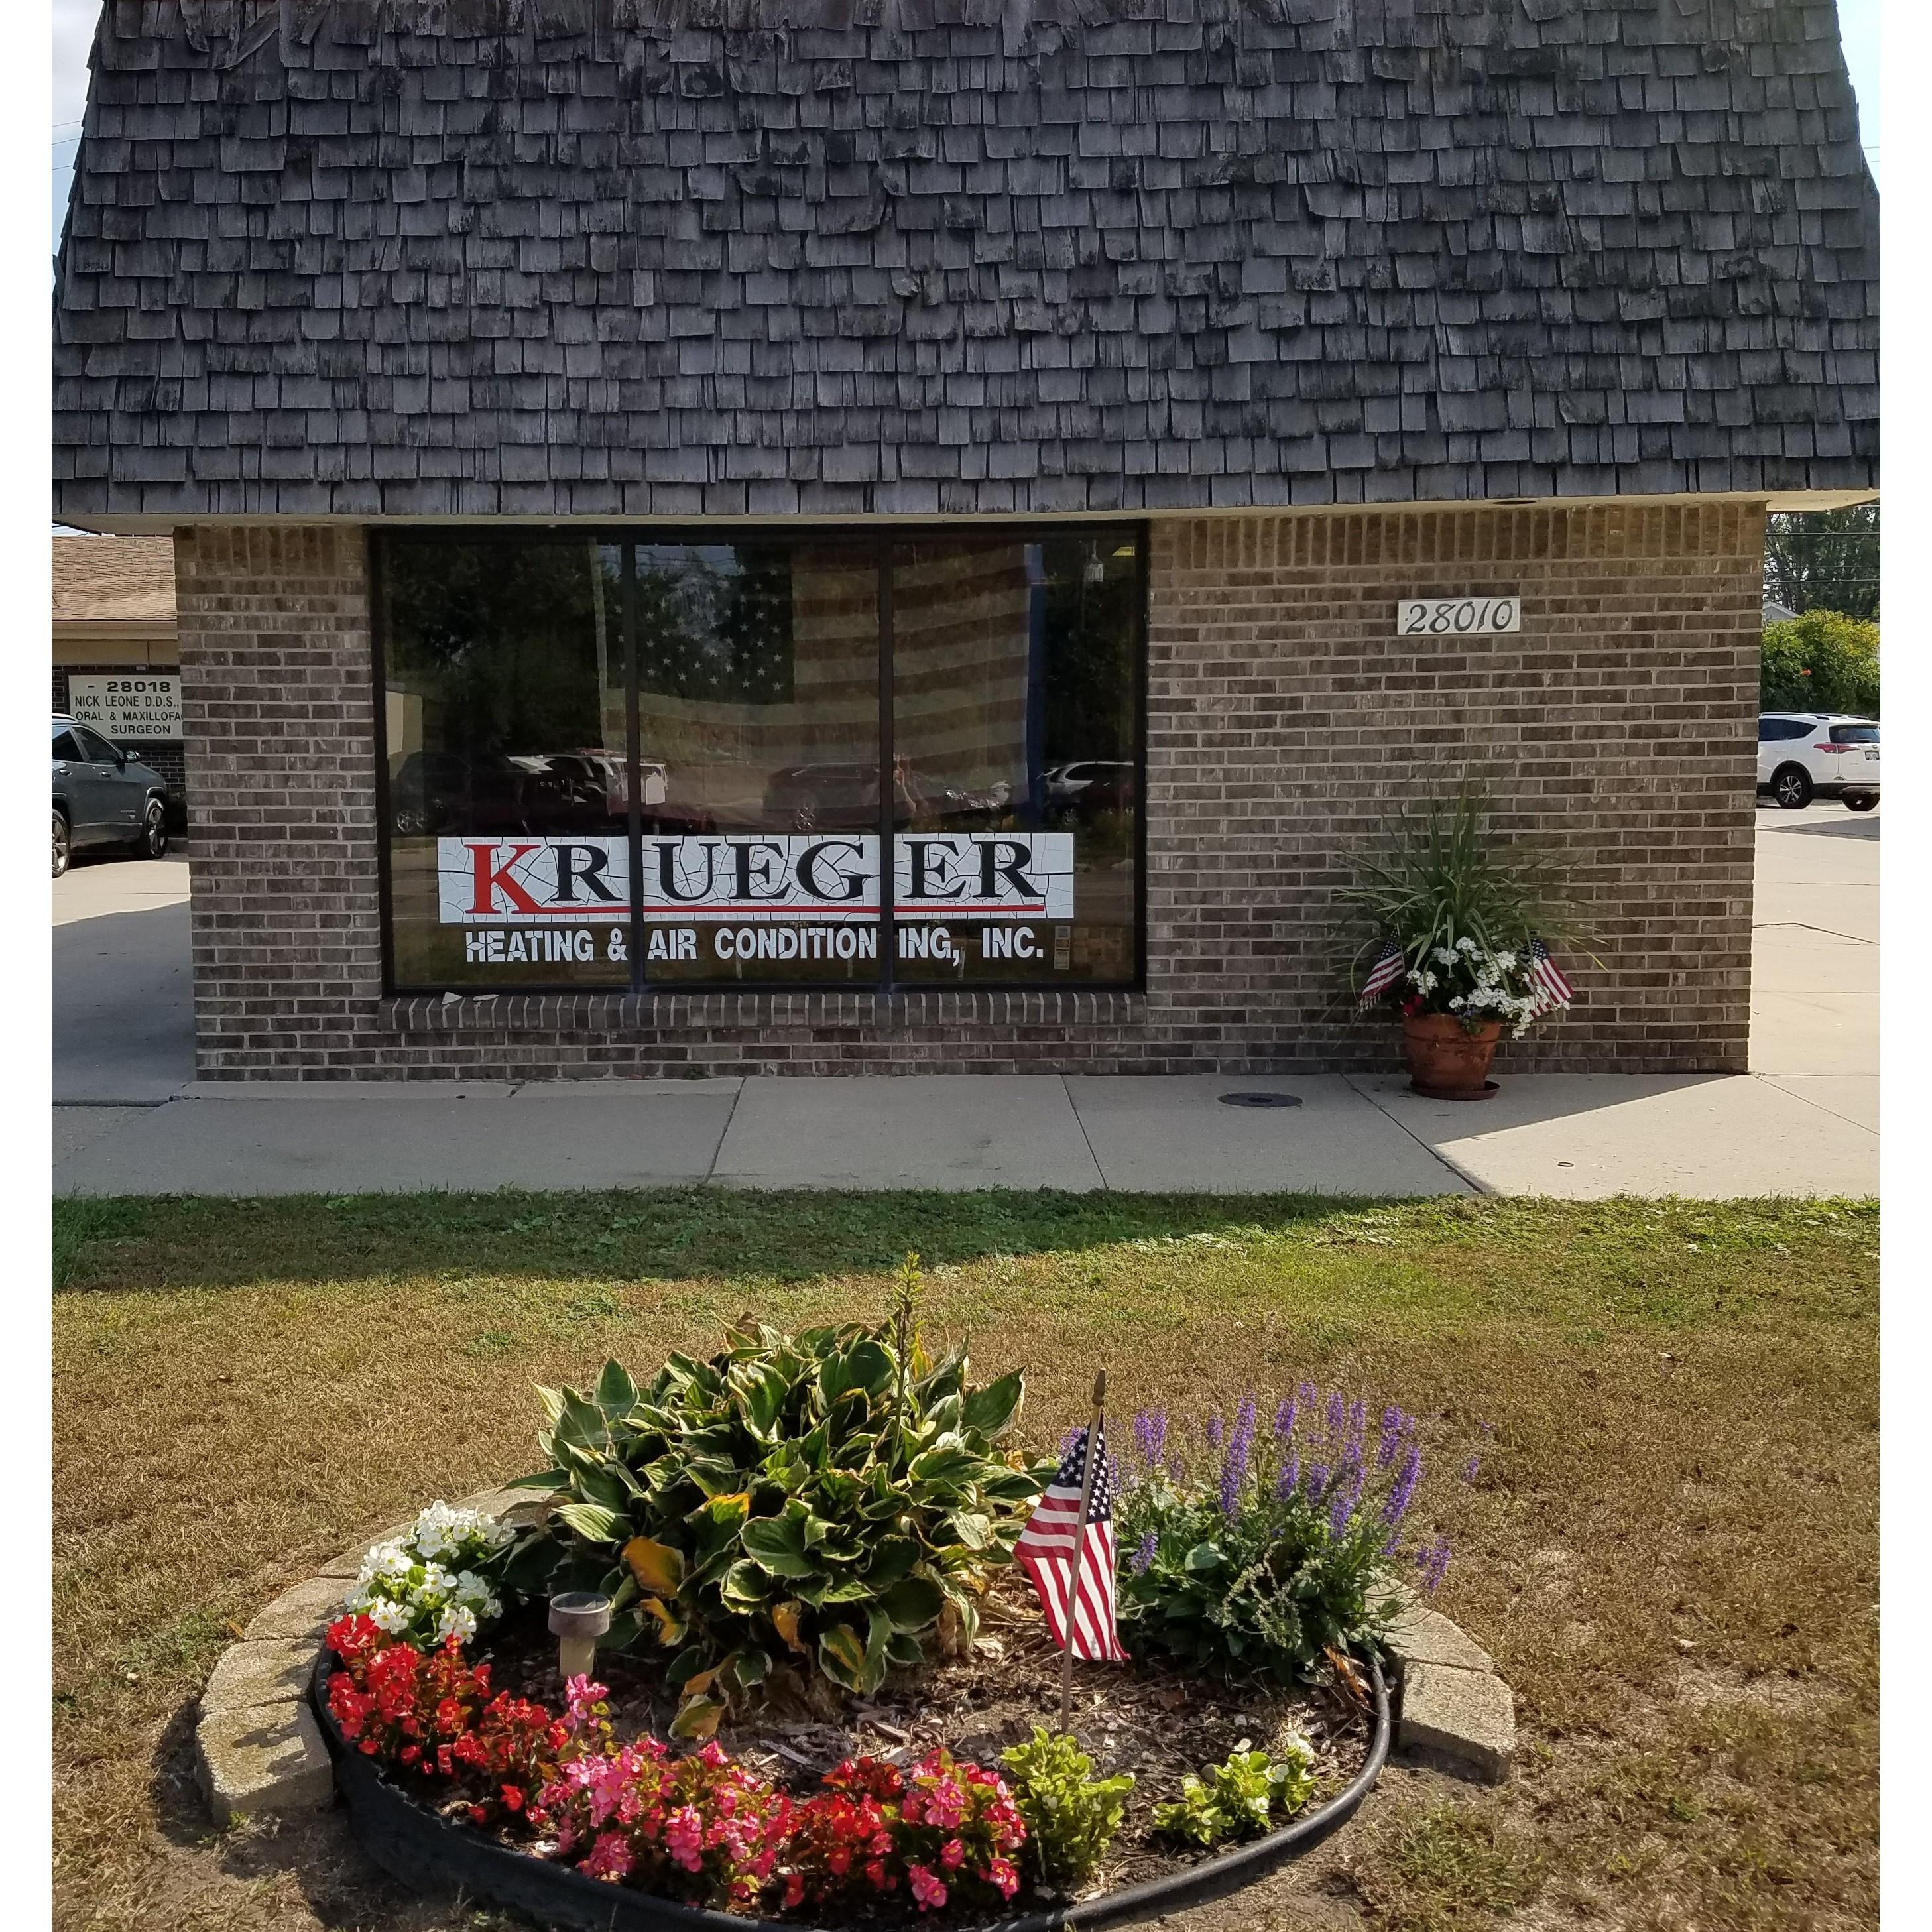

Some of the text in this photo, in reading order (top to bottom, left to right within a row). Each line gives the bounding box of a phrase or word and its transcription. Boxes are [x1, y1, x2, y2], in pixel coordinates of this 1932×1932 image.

[1405, 600, 1513, 634] 28010
[107, 681, 171, 692] 28018
[75, 695, 100, 707] NICK
[105, 695, 139, 707] LEONE
[76, 711, 183, 721] ORAL & MAXILLOFA
[111, 725, 170, 734] SURGEON
[464, 839, 1046, 914] KRUEGER
[465, 929, 595, 962] HEATING
[607, 928, 628, 961] &
[647, 928, 697, 960] AIR
[982, 927, 1044, 959] INC.
